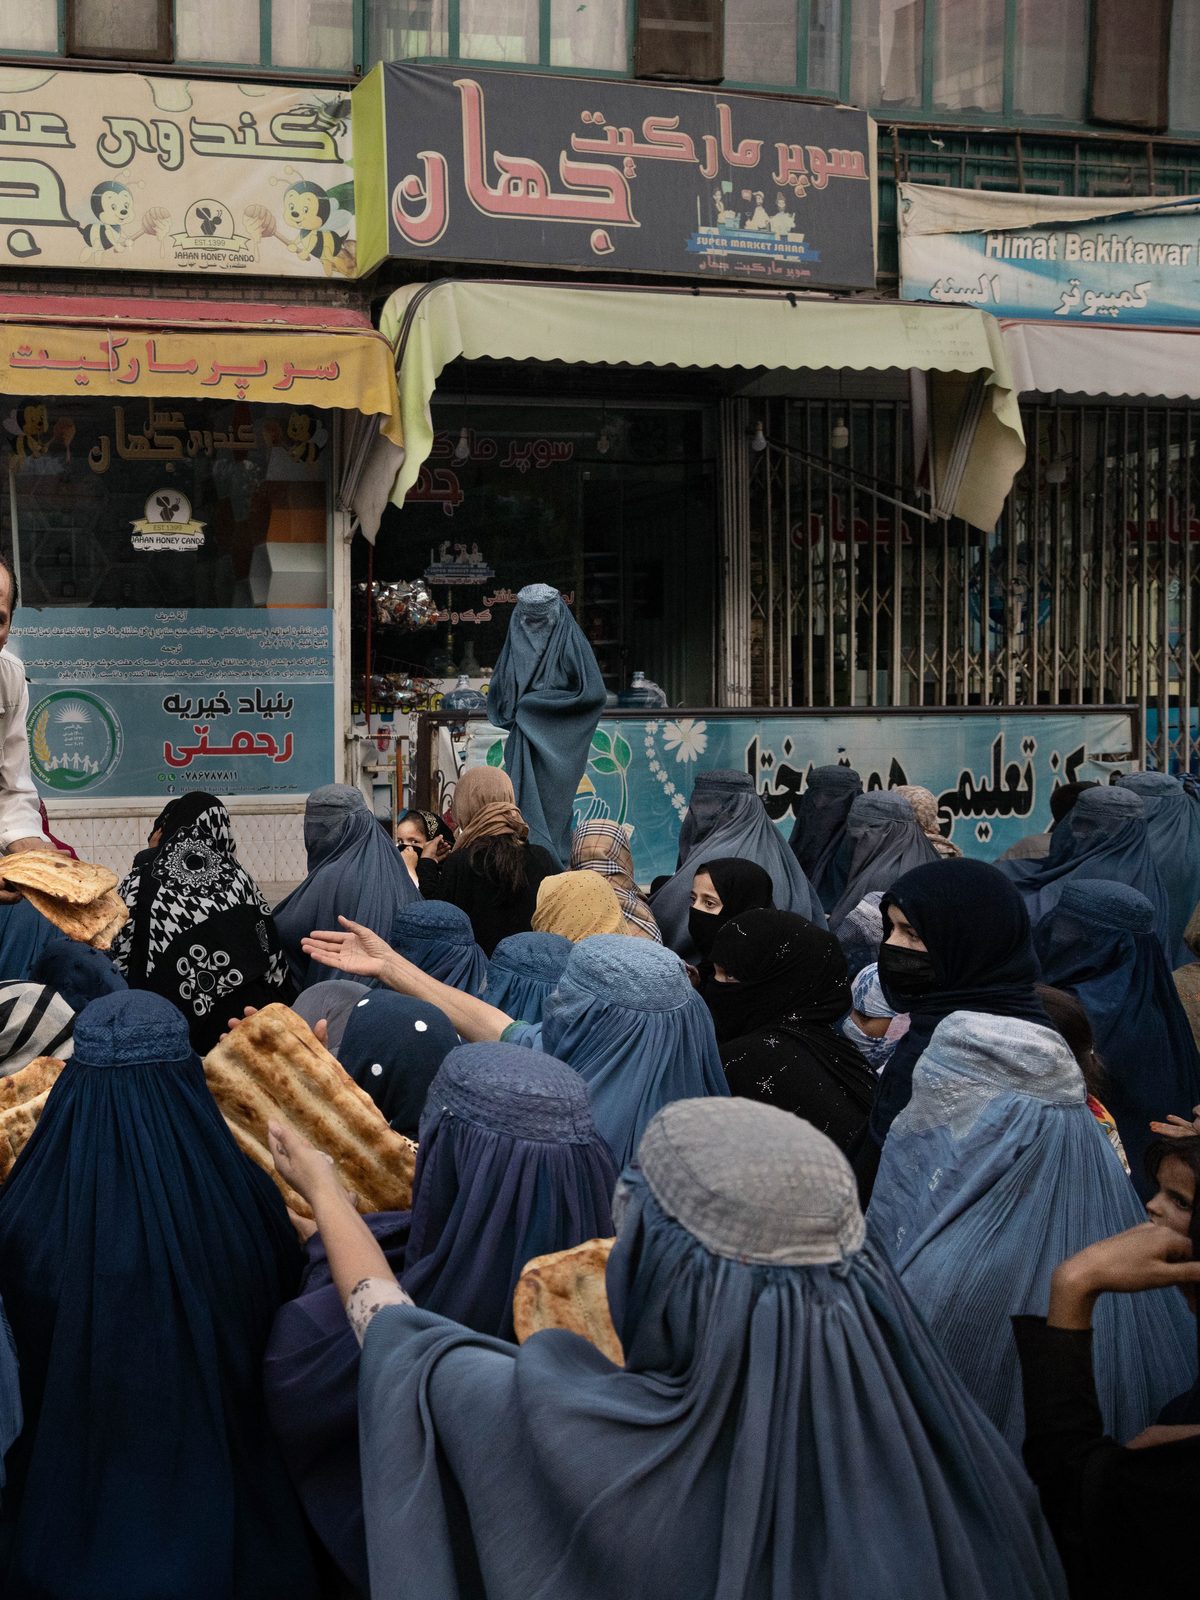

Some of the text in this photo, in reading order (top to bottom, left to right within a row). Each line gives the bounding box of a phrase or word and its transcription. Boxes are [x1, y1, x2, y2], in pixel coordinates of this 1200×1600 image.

[99, 108, 344, 171] کندوی
[391, 77, 642, 255] جهان
[771, 141, 870, 199] سوپر
[173, 251, 255, 263] JAHAN HONEY CANDO
[696, 236, 806, 254] SUPER MARKET JAHAN
[984, 232, 1058, 261] Himat
[1064, 232, 1193, 267] Bakhtawar
[156, 536, 180, 545] HONEY
[181, 537, 205, 546] CANDO
[161, 687, 294, 720] بنیاد خیریه
[162, 725, 295, 768] رحمتی
